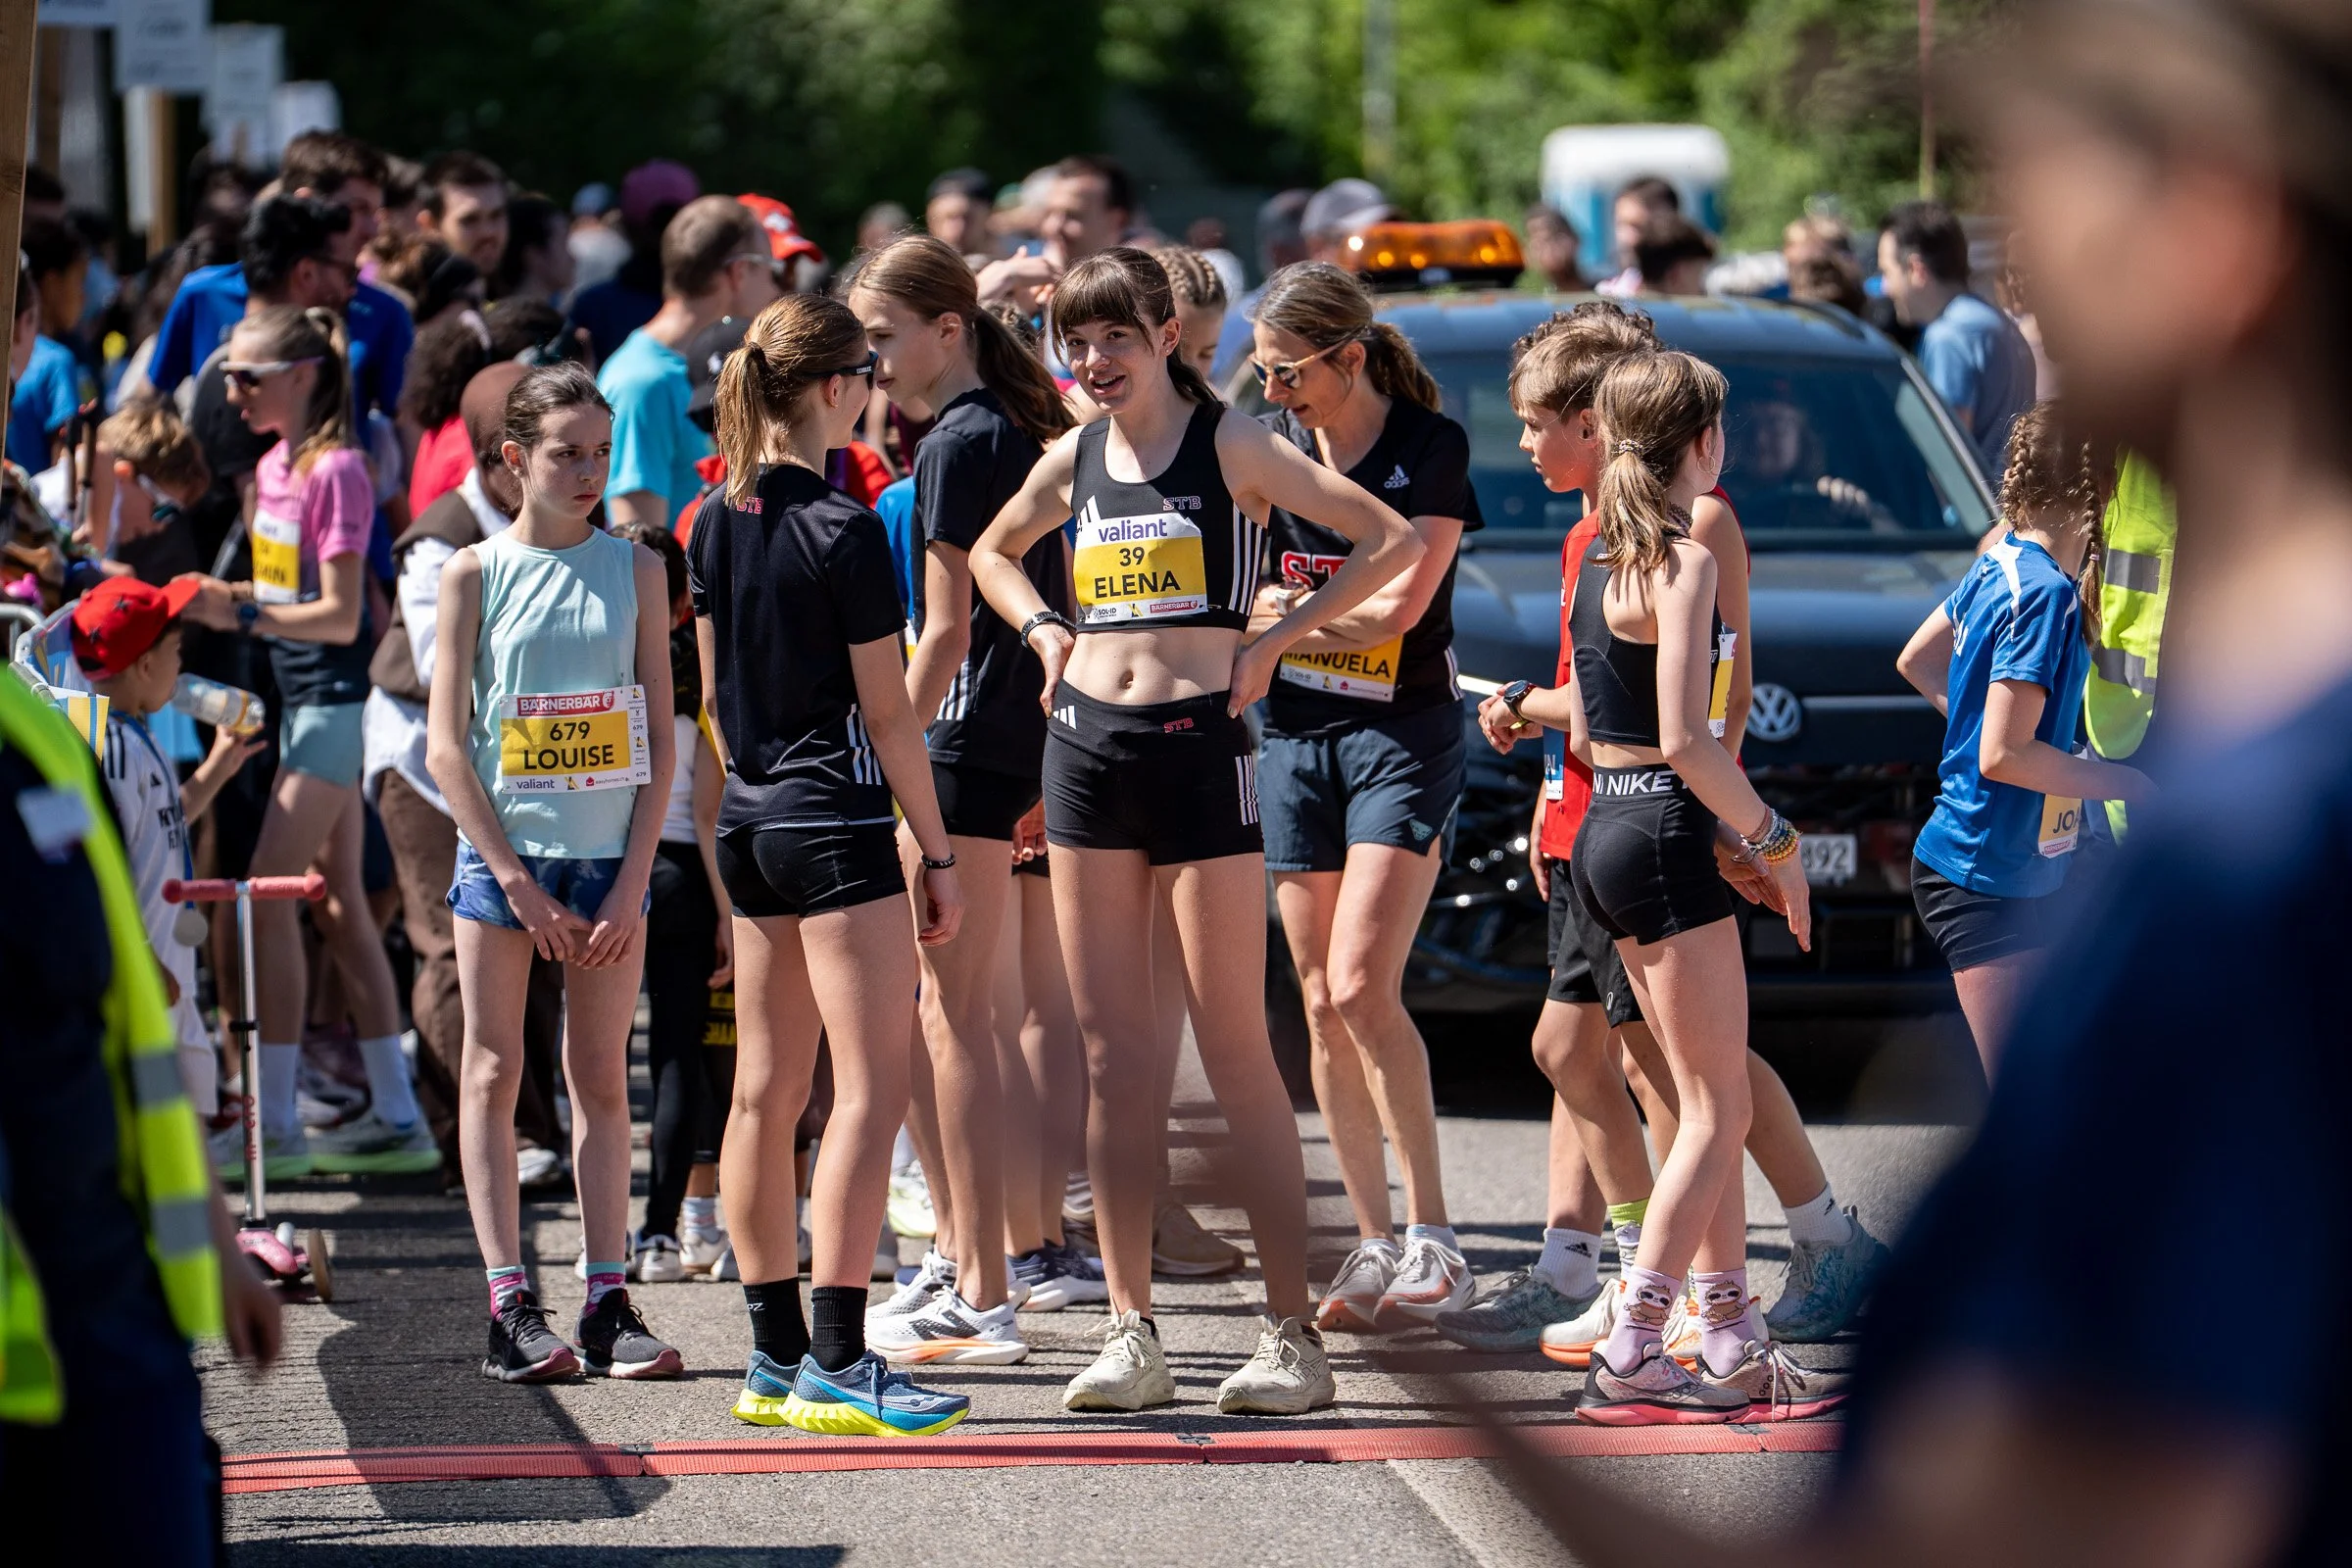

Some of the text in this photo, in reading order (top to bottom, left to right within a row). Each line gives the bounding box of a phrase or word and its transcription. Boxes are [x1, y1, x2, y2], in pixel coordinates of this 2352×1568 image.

[1163, 496, 1201, 511] STB
[1099, 518, 1168, 543] valiant
[1118, 546, 1146, 567] 39
[1094, 570, 1182, 599] ELENA
[520, 695, 600, 710] BÄRNERBÄR
[549, 721, 591, 741] 679
[1163, 717, 1194, 733] STB
[523, 744, 614, 770] LOUISE
[516, 778, 555, 790] valiant
[1606, 769, 1677, 796] NIKE
